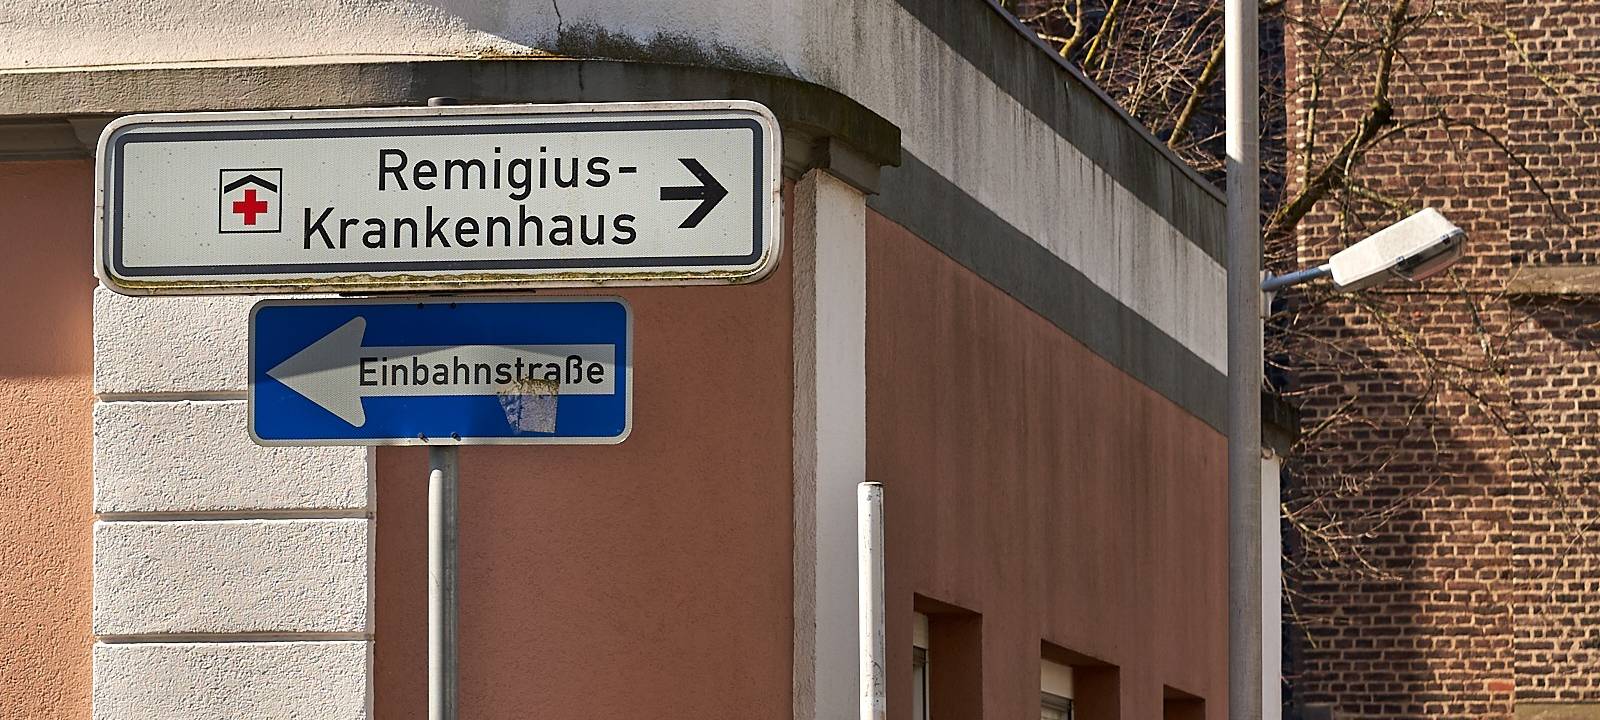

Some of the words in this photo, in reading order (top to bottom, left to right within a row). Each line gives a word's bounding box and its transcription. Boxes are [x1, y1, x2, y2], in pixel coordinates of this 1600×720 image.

[378, 146, 638, 200] Remigius-
[303, 205, 638, 250] Krankenhaus
[359, 354, 605, 387] Einbahnstraße
